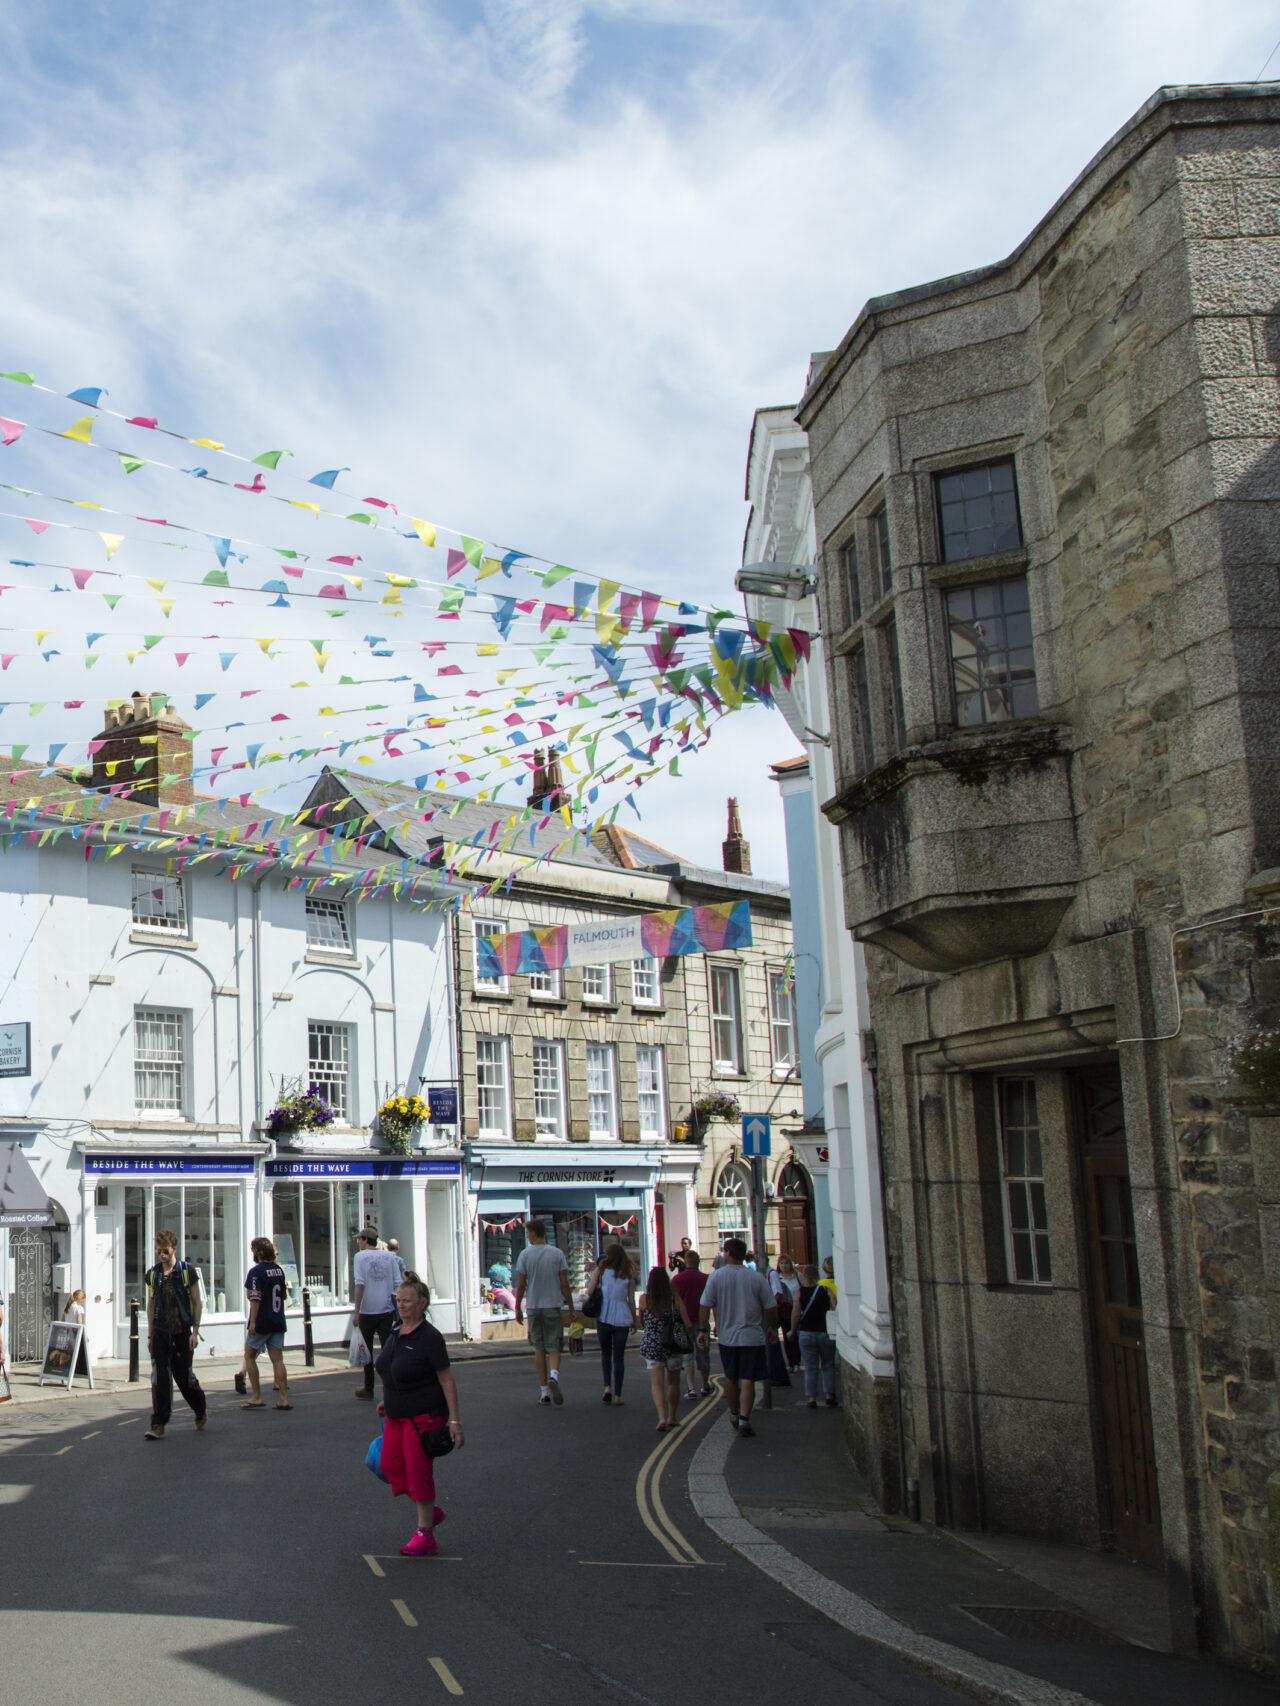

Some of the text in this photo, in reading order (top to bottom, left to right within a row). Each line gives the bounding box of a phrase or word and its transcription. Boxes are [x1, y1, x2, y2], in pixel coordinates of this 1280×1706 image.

[573, 926, 635, 944] FALMOUTH
[0, 1056, 21, 1066] BAKERY
[92, 1160, 129, 1169] BESIDE
[134, 1160, 154, 1169] THE
[159, 1160, 185, 1169] WAVE
[273, 1164, 304, 1173] BESIDE
[307, 1164, 325, 1173] THE
[327, 1164, 350, 1173] WAVE
[518, 1171, 603, 1183] THE CORNISH STORE
[0, 1214, 26, 1223] Roasted
[26, 1214, 48, 1222] Coffee
[272, 1284, 282, 1313] 6
